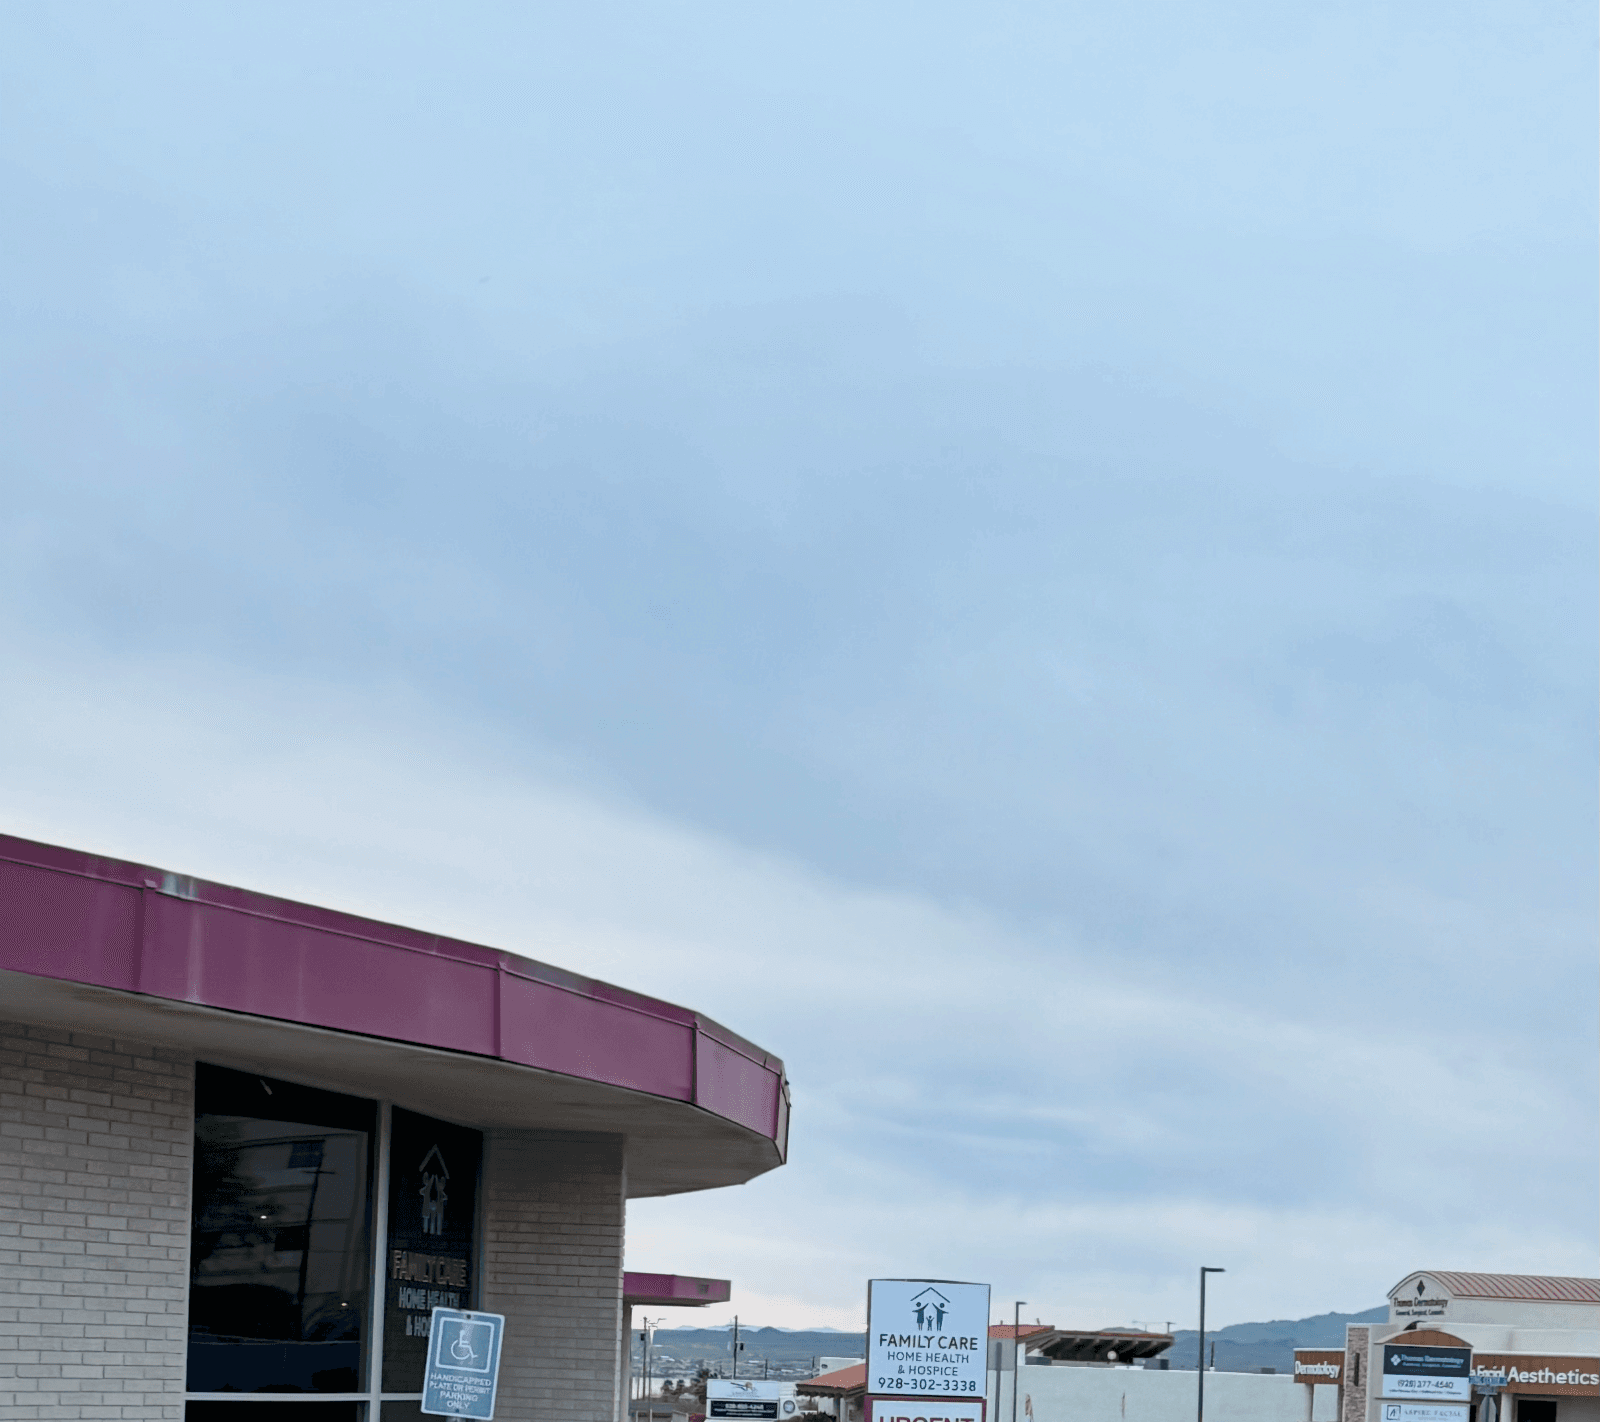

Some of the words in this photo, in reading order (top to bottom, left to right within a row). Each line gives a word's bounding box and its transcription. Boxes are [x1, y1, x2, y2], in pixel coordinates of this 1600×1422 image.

[393, 1249, 436, 1284] FAMILY
[437, 1255, 467, 1288] CARE
[399, 1286, 426, 1310] HOME
[427, 1289, 460, 1310] HEALTH
[879, 1333, 935, 1349] FAMILY
[937, 1335, 978, 1350] CARE
[887, 1351, 922, 1362] HOME
[925, 1352, 969, 1364] HEALTH
[897, 1364, 905, 1374] &
[908, 1365, 958, 1377] HOSPICE
[1295, 1361, 1340, 1378] Dermatology
[1506, 1366, 1599, 1385] Aesthetics
[429, 1380, 452, 1390] PLATE
[430, 1372, 492, 1386] HANDICAPPED
[878, 1377, 976, 1392] 928-302-3338
[440, 1390, 478, 1402] PARKING
[446, 1400, 470, 1410] ONLY
